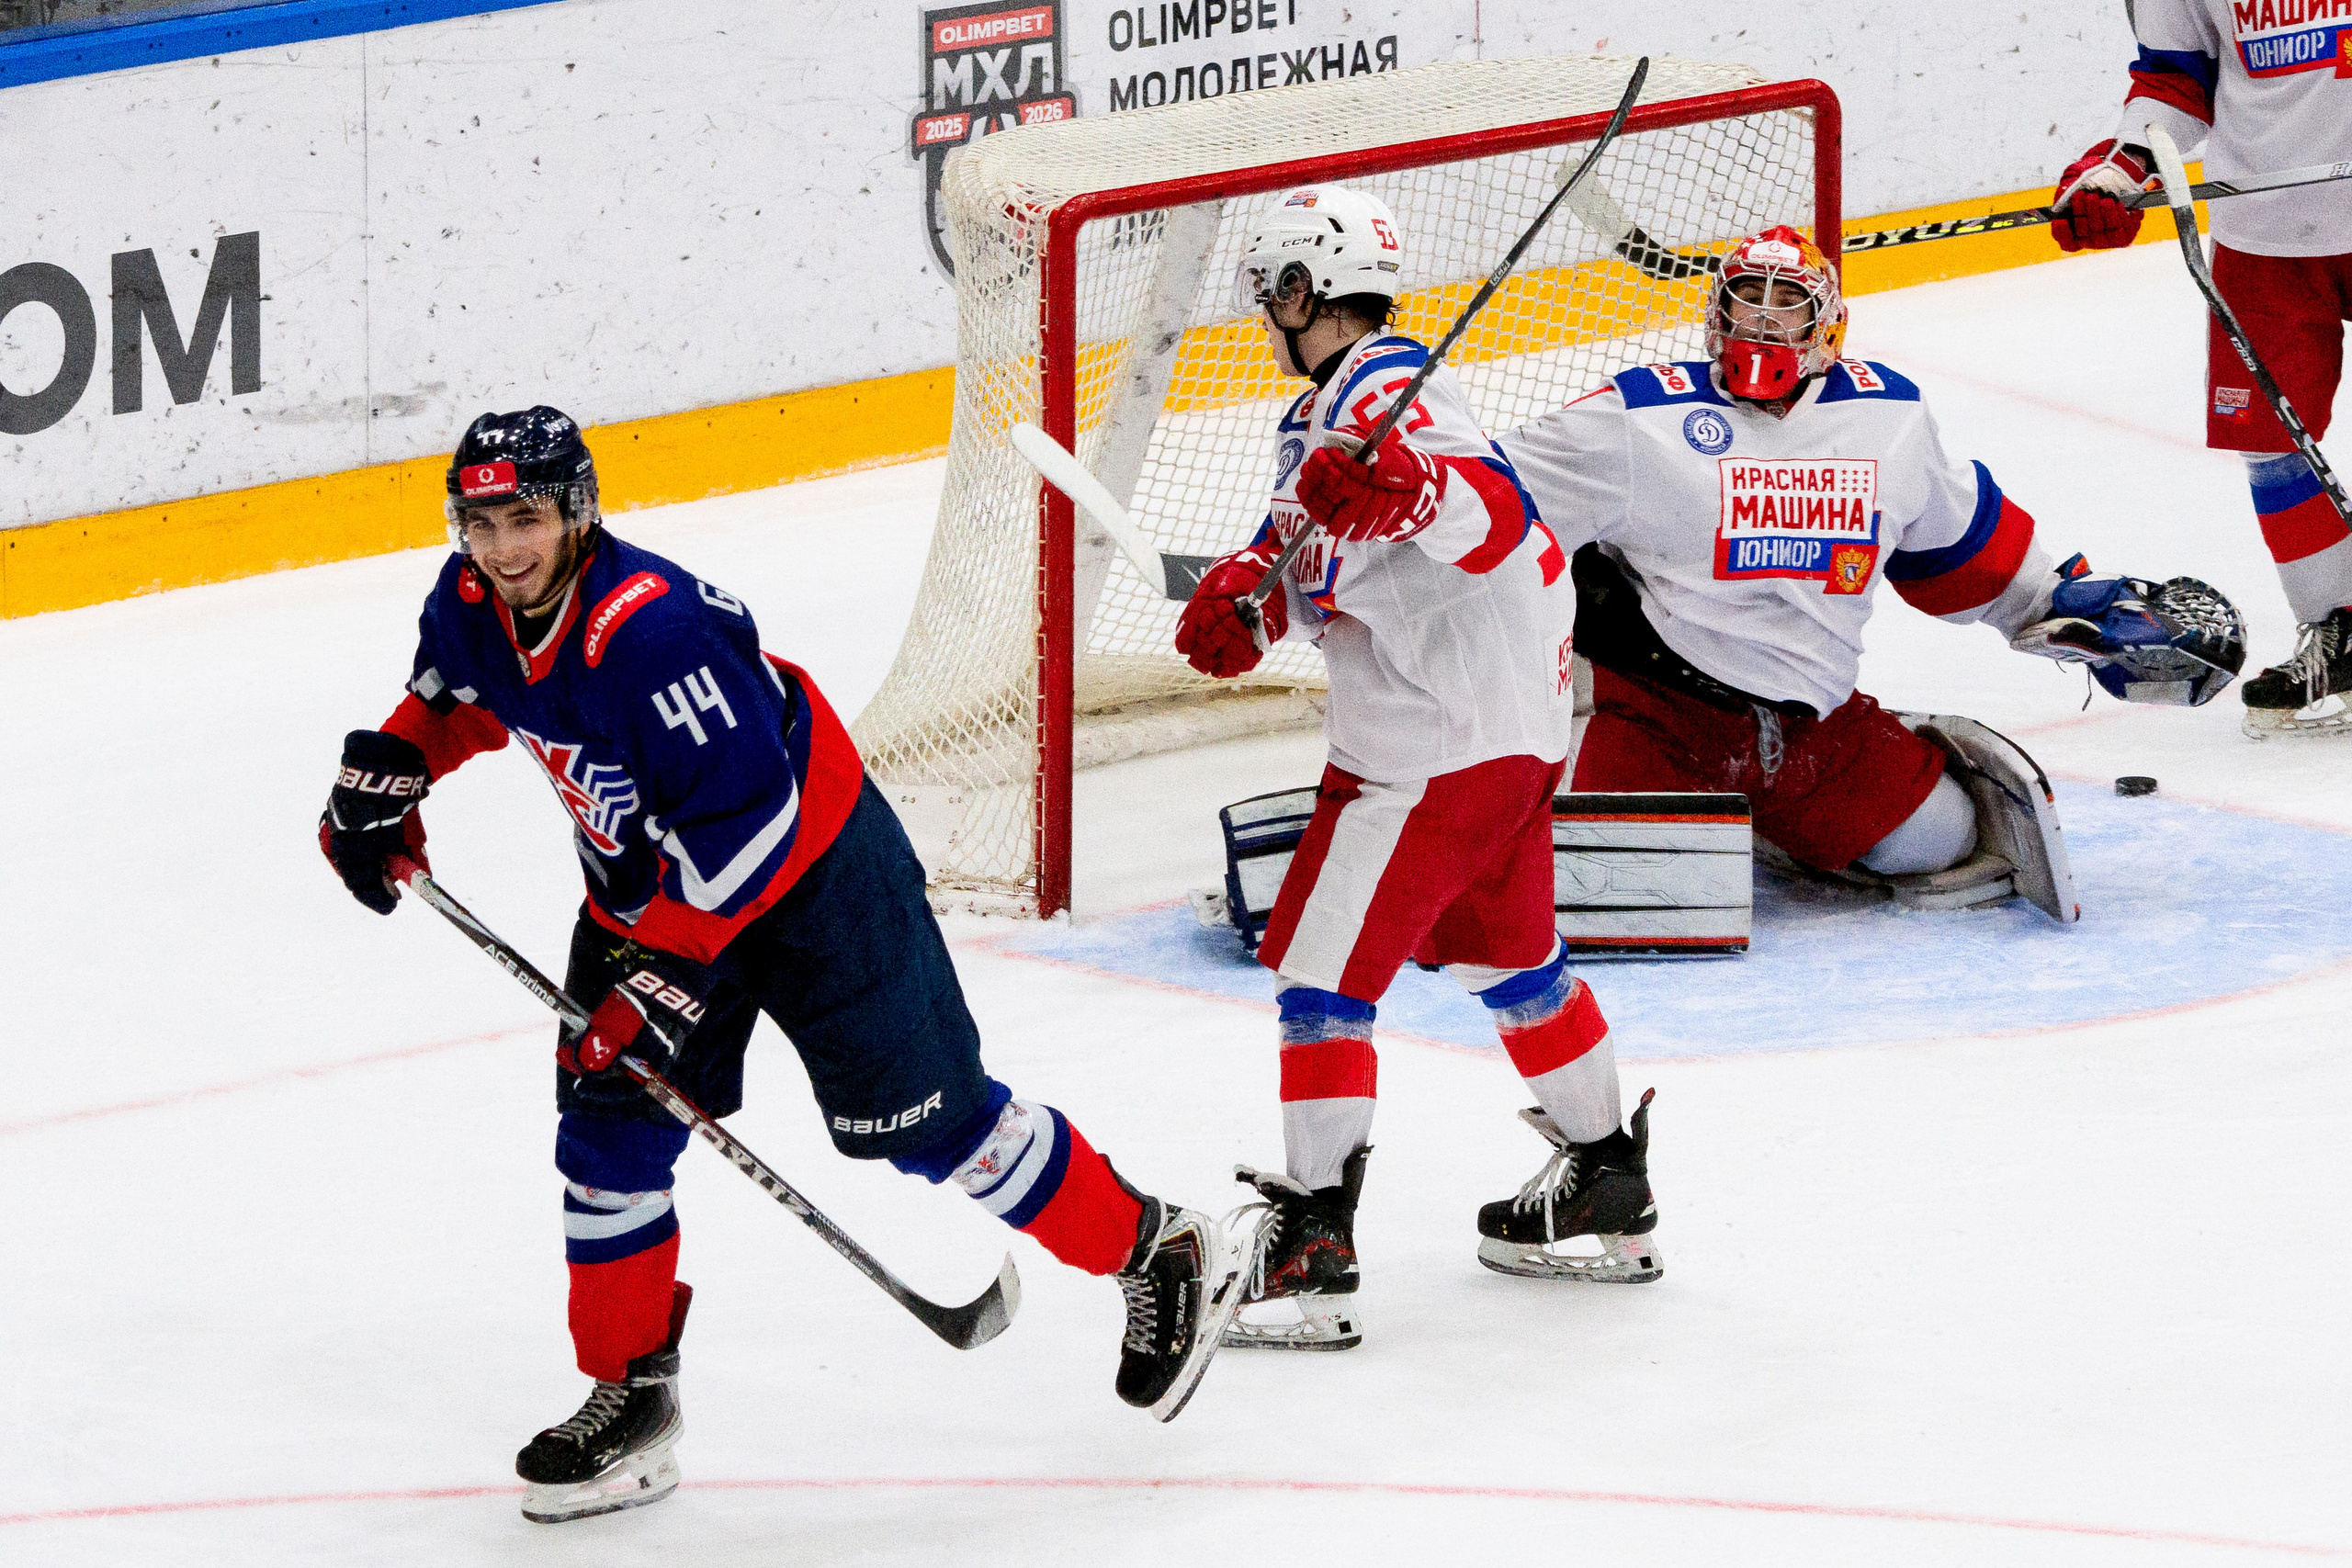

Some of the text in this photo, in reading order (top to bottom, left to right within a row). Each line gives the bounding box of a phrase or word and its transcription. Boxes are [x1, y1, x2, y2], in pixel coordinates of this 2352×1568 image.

[939, 13, 1046, 45] OLIMPBET
[2247, 30, 2326, 69] ЮНИОР
[933, 42, 1055, 110] МХЛ
[1109, 35, 1398, 113] МОЛОДЕЖНАЯ
[924, 117, 963, 141] 2025
[1024, 102, 1064, 125] 2026
[1281, 235, 1314, 248] CCM
[1748, 353, 1762, 385] 1
[465, 481, 514, 497] OLIMPBET
[1731, 466, 1836, 492] КРАСНАЯ
[1730, 494, 1866, 532] МАШИНА
[1736, 538, 1822, 569] ЮНИОР
[586, 577, 658, 657] OLIMPBET
[650, 665, 739, 747] 44
[483, 942, 518, 975] ACE
[627, 970, 707, 1027] BAU
[832, 1089, 943, 1134] BAUER
